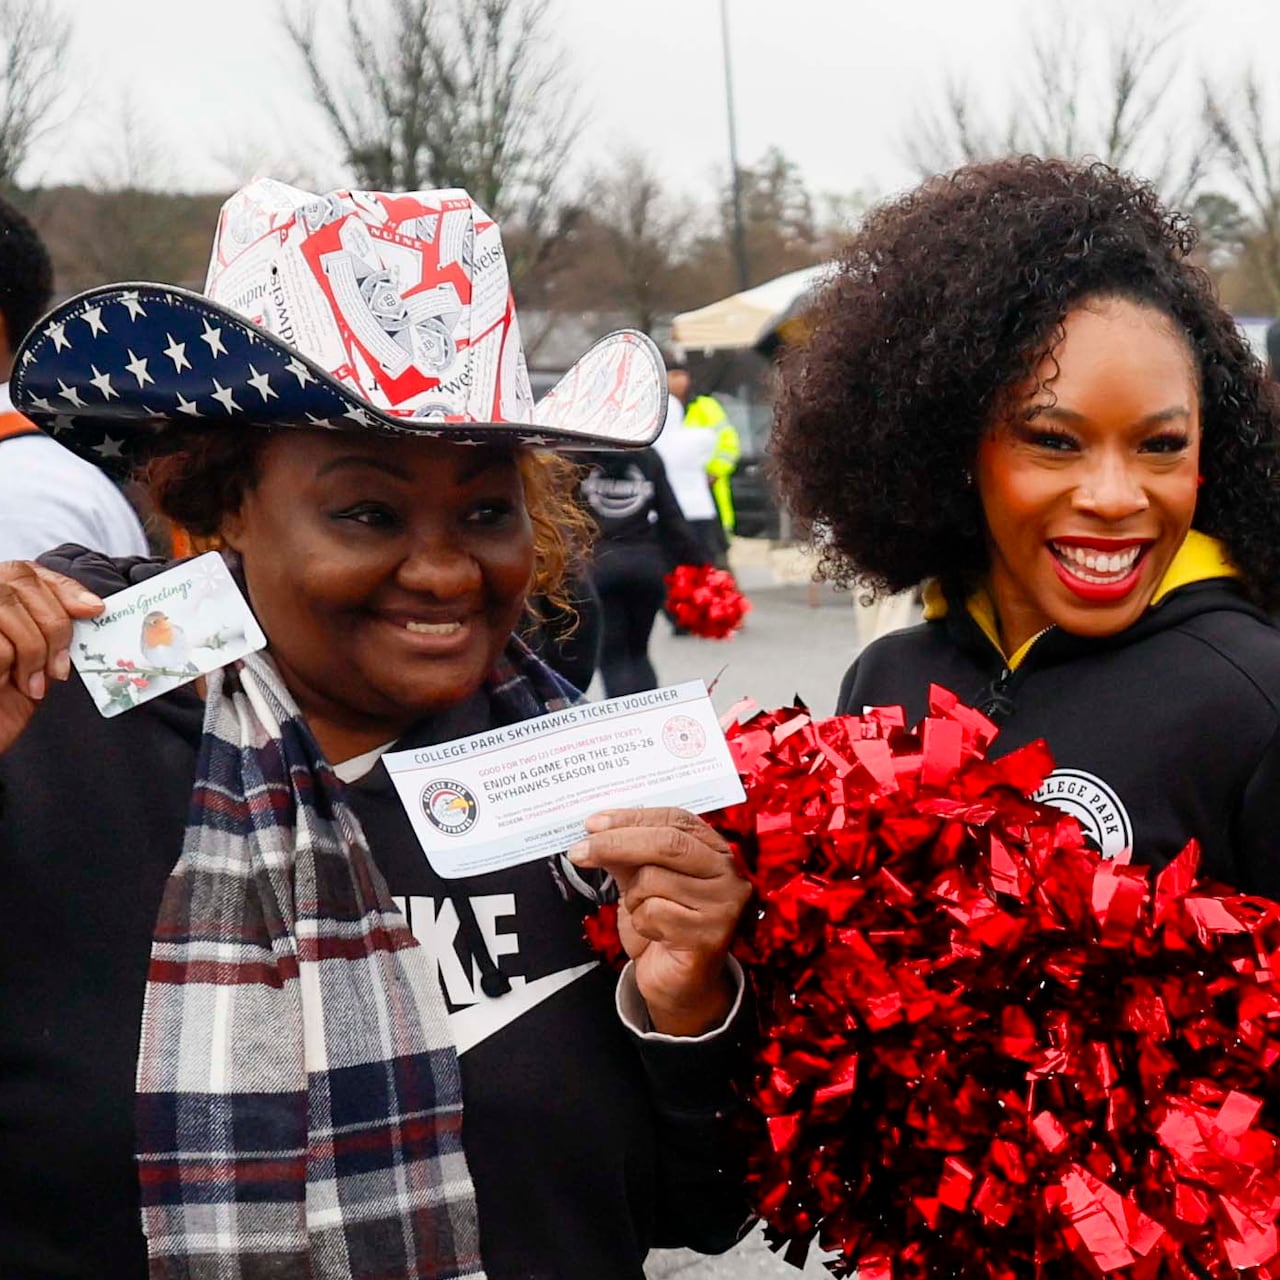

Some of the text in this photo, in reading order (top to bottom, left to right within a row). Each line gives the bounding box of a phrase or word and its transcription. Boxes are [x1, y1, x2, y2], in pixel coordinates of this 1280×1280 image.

[136, 577, 193, 614] Greetings
[414, 688, 679, 765] COLLEGE PARK SKYHAWKS TICKET VOUCHER
[483, 737, 655, 791] ENJOY A GAME FOR THE 2025-26
[487, 755, 631, 804] SKYHAWKS SEASON ON US
[1090, 793, 1119, 836] PARK
